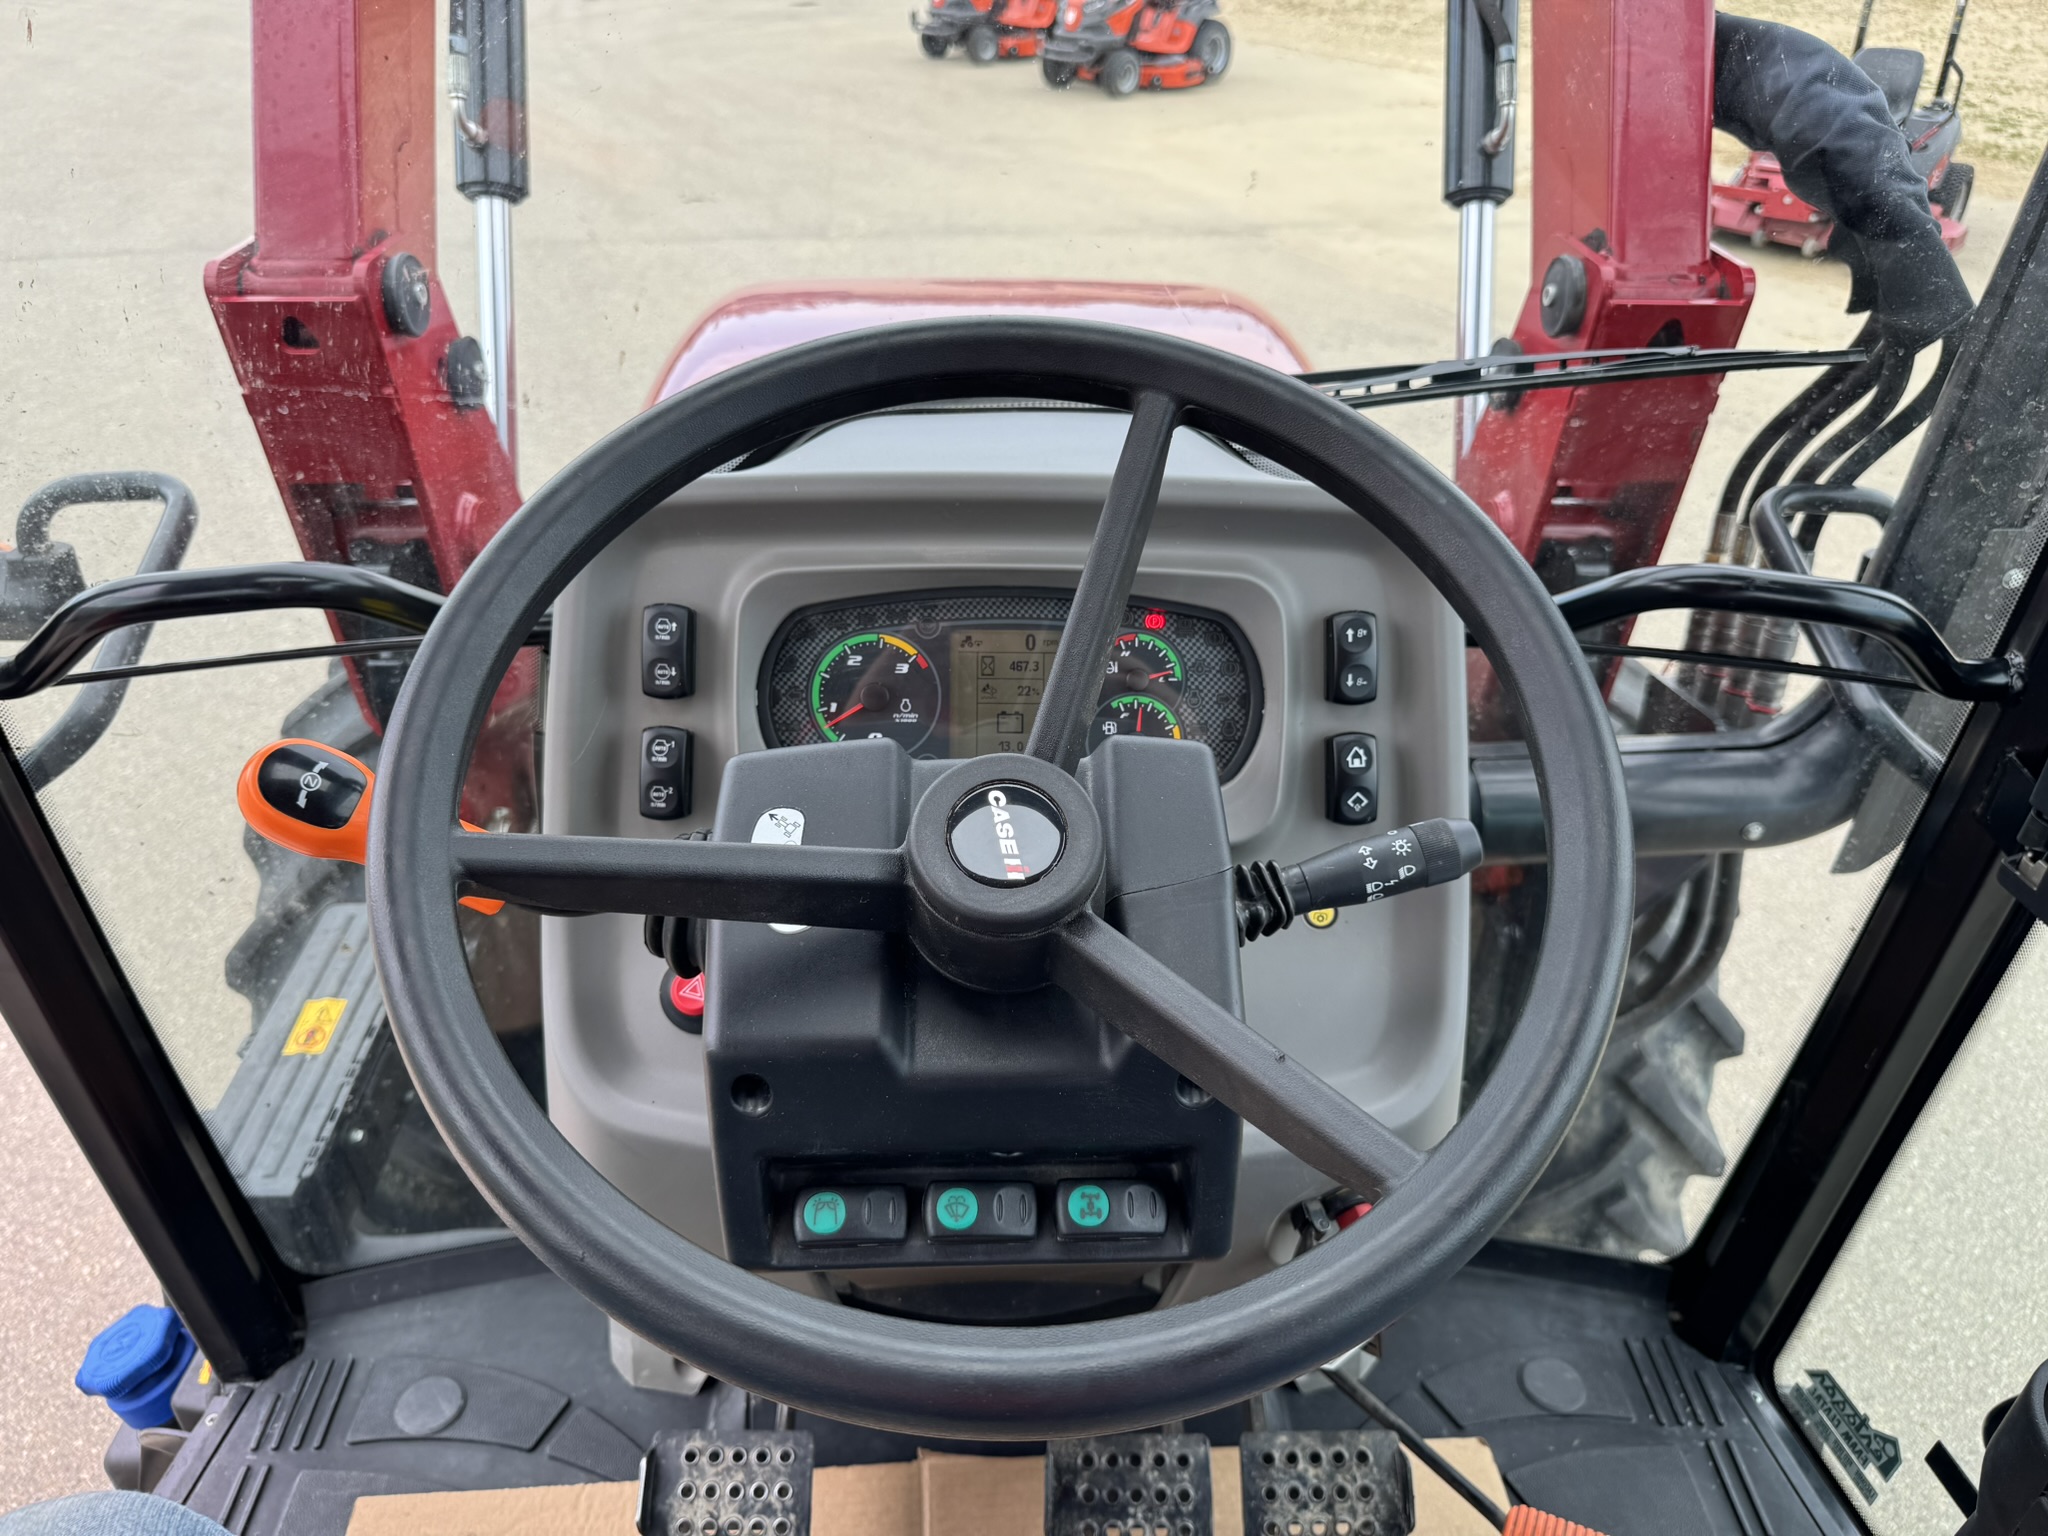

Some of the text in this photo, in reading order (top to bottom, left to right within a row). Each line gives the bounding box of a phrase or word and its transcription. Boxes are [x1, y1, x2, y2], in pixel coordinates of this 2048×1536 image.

[1025, 634, 1036, 651] 0
[846, 655, 863, 666] 2
[894, 663, 910, 674] 3
[1009, 661, 1040, 672] 467.3
[829, 702, 838, 713] 1
[303, 775, 319, 788] N
[988, 790, 1020, 854] CASE
